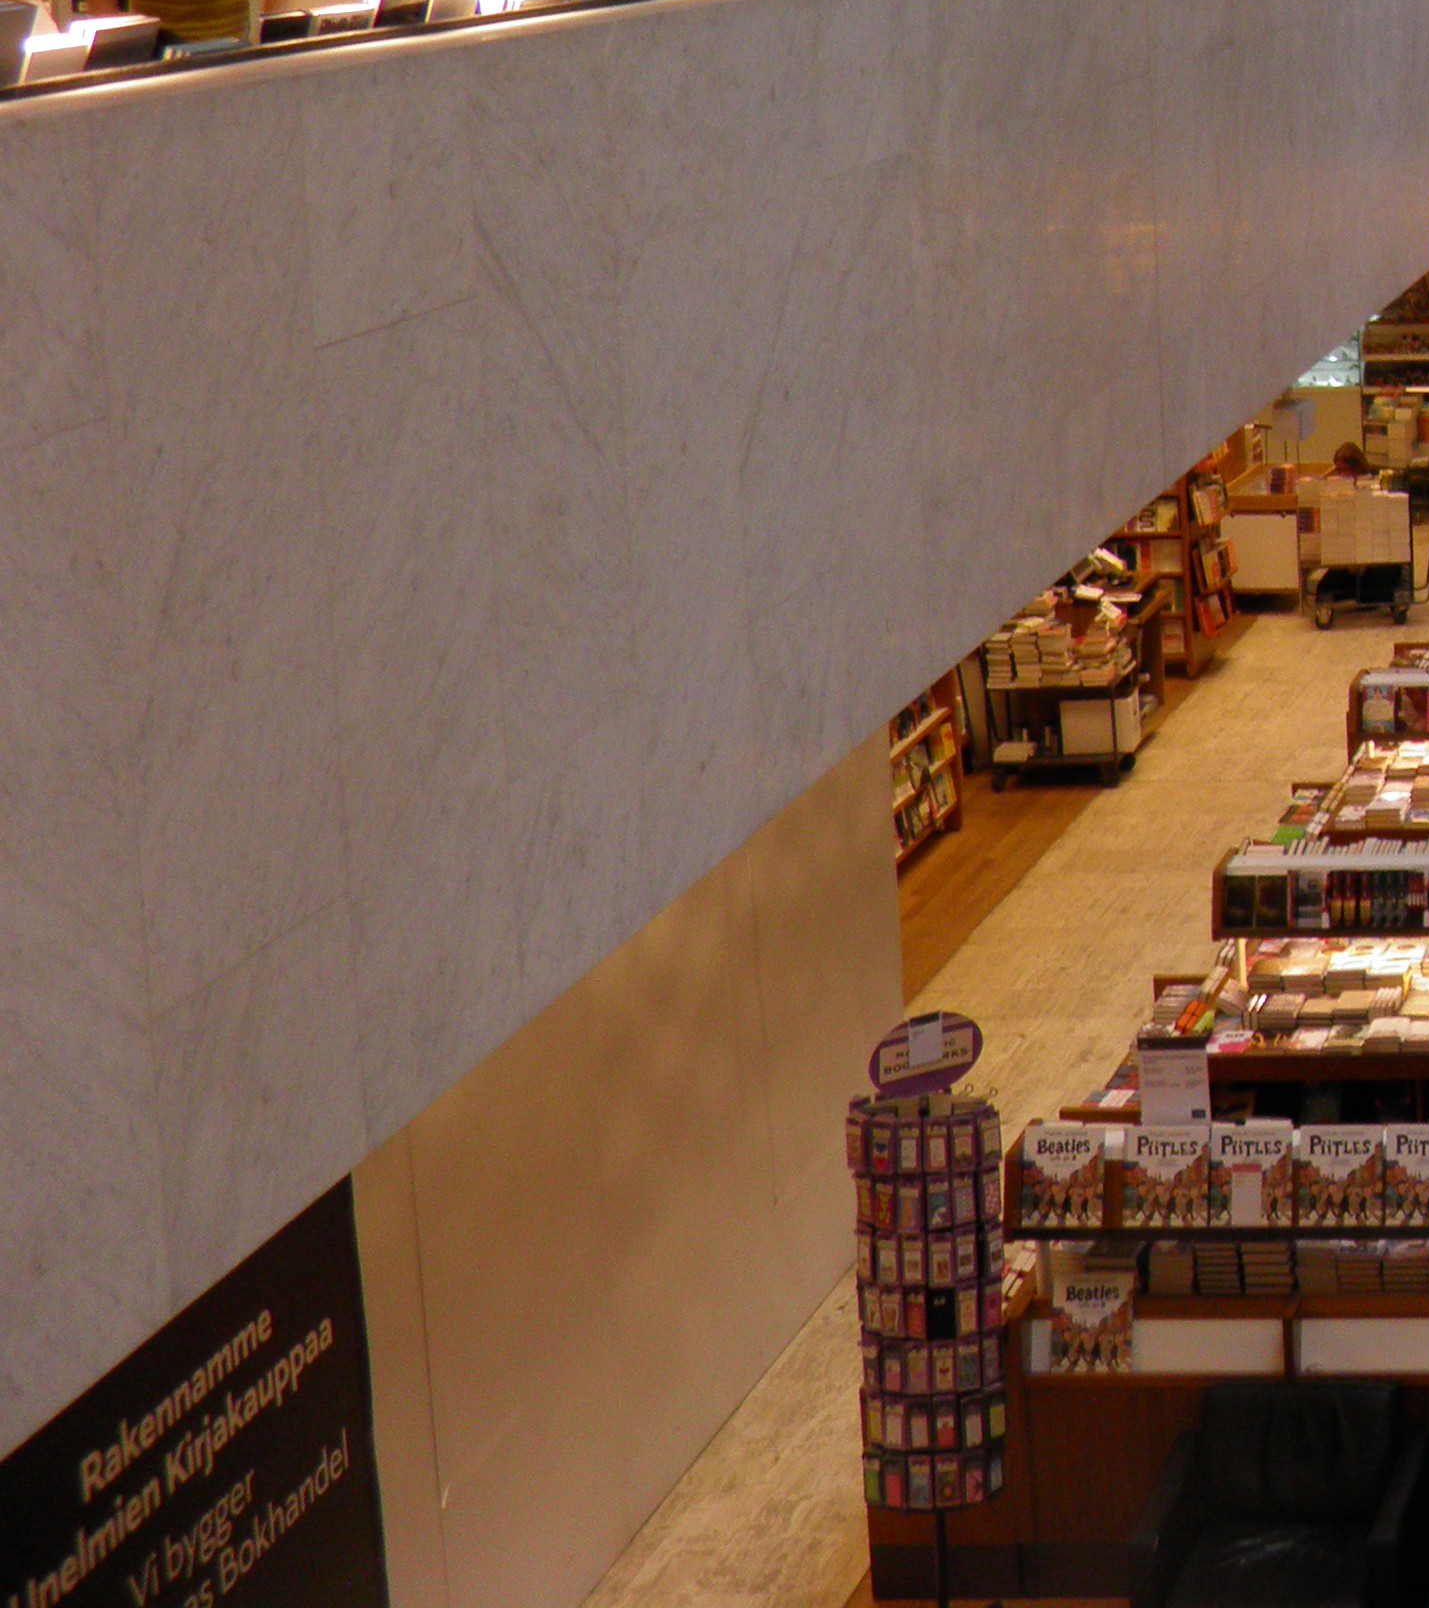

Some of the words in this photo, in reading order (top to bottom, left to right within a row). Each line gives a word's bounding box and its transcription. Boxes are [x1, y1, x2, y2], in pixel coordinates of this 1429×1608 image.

[1037, 1138, 1091, 1155] Beatles
[1066, 1285, 1120, 1302] Beatles
[81, 1308, 272, 1502] Rakennamme
[165, 1314, 334, 1493] Kirjakauppaa
[127, 1552, 160, 1608] Vi
[165, 1468, 256, 1581] bygger
[219, 1428, 350, 1595] Bokhandel
